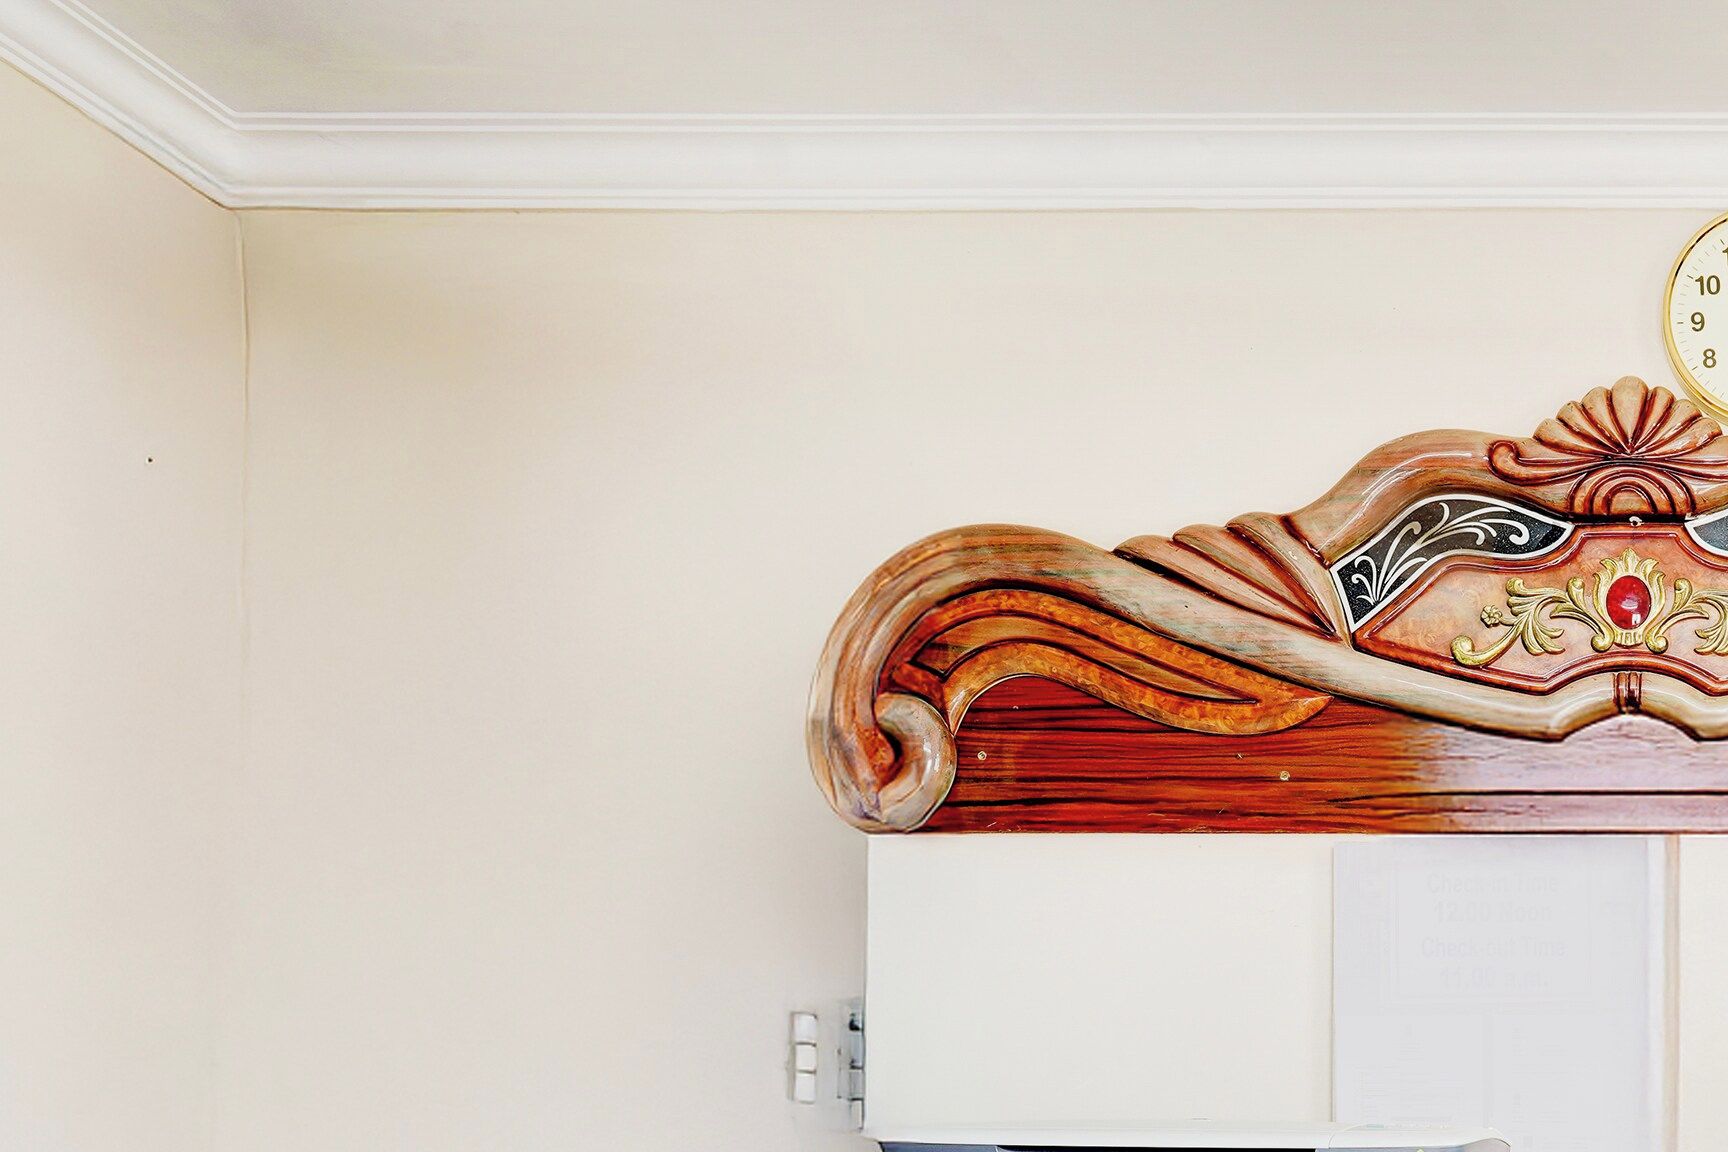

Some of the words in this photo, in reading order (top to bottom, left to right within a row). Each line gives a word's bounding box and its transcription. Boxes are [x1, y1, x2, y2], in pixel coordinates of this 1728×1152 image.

[1694, 274, 1721, 296] 10
[1690, 311, 1705, 332] 9
[1702, 348, 1717, 369] 8
